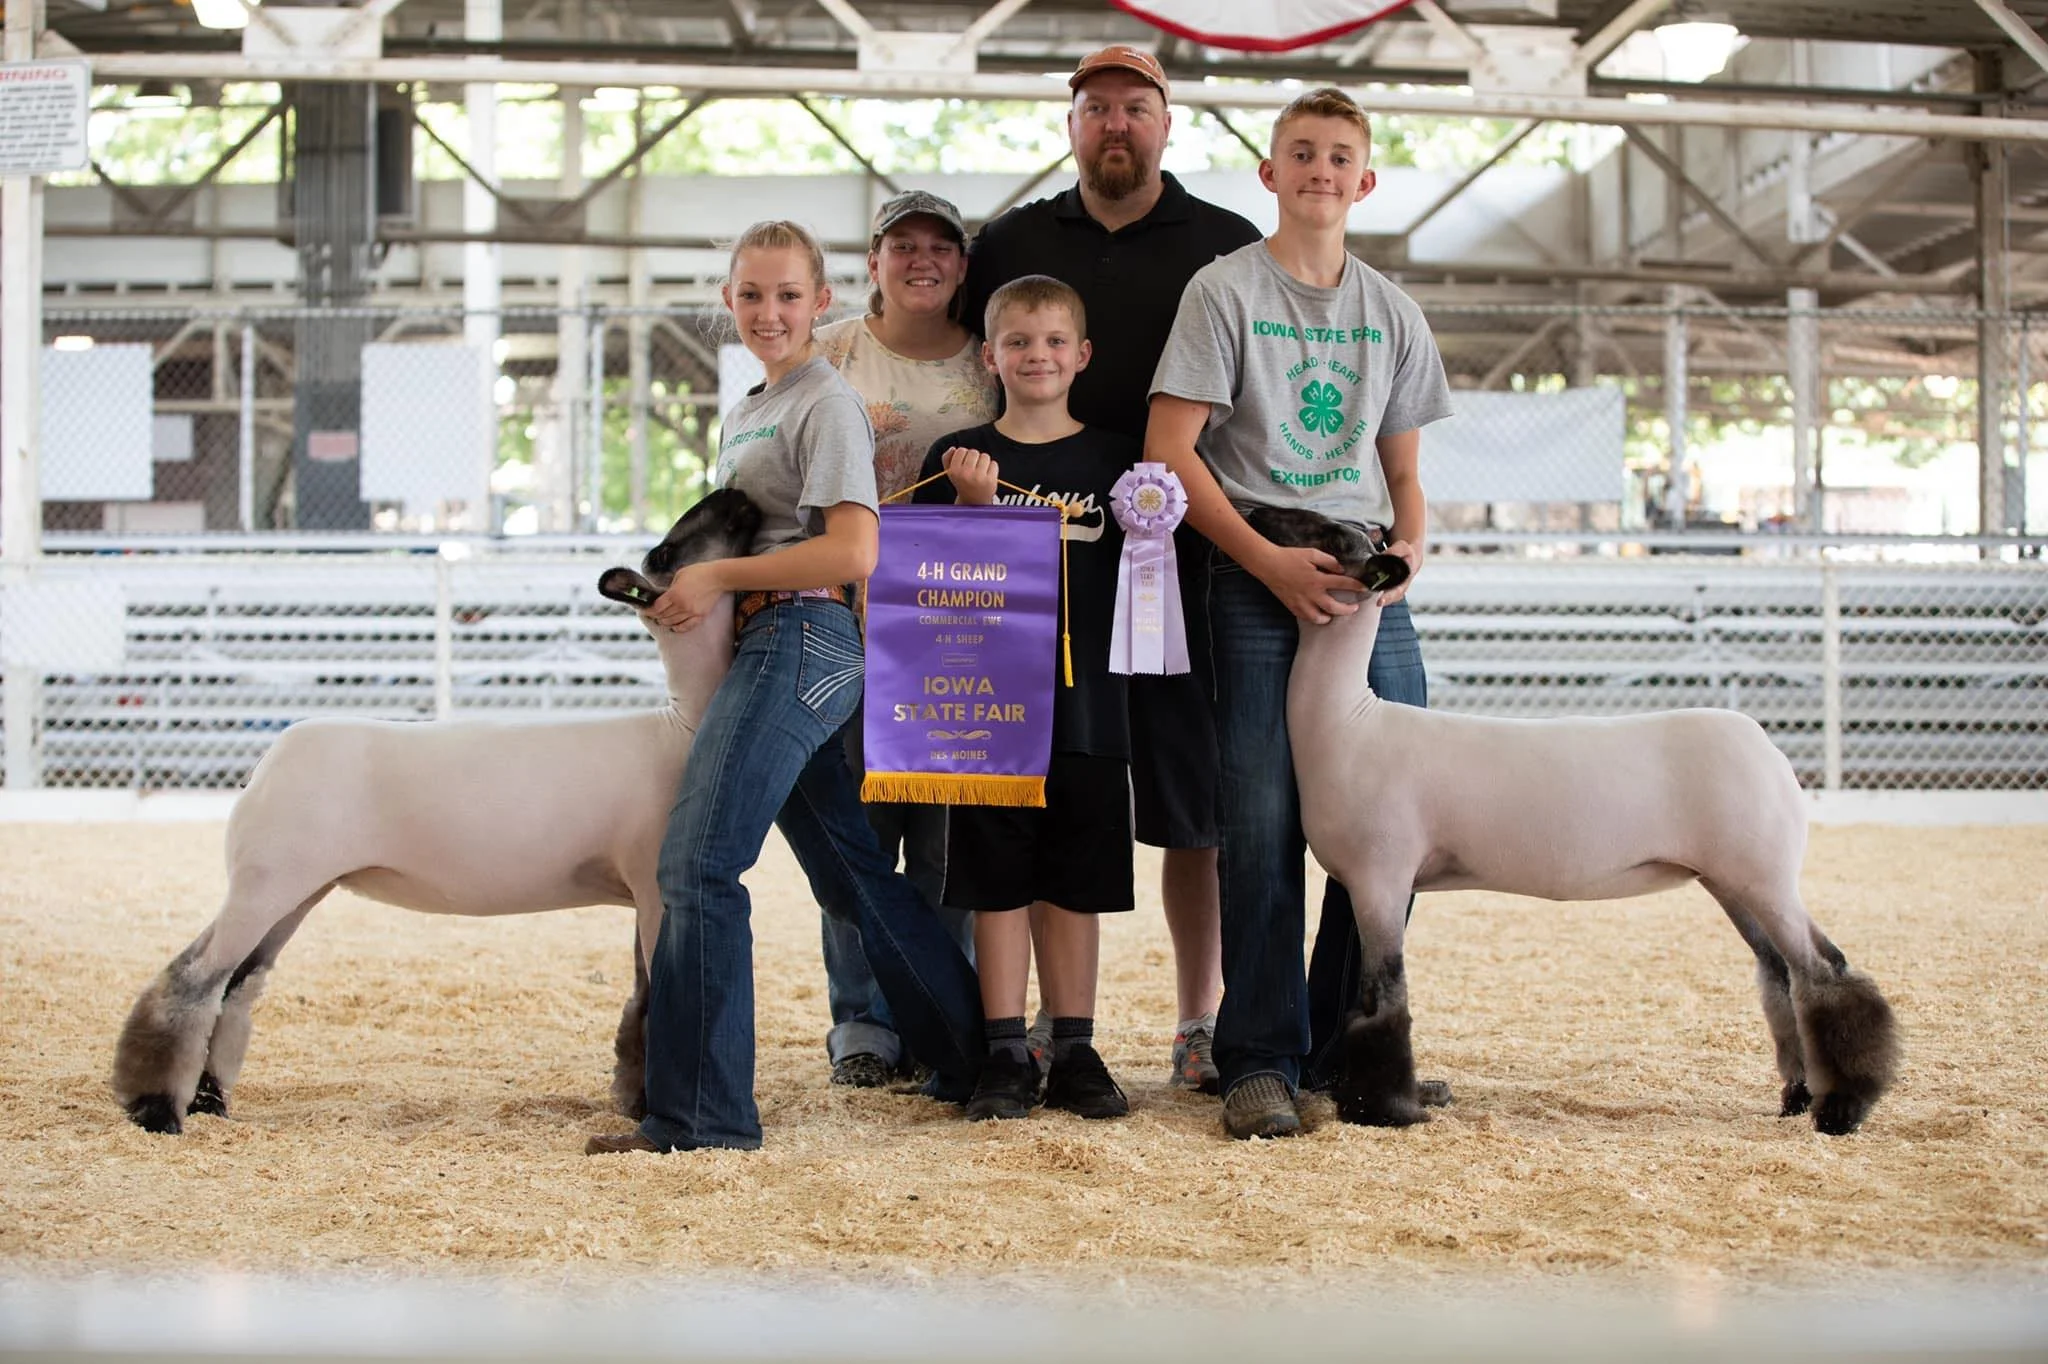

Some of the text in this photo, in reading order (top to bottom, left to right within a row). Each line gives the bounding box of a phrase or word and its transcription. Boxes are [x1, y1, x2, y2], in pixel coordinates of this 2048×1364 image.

[1253, 320, 1298, 341] IOWA
[1286, 357, 1318, 381] HEAD
[1279, 419, 1368, 461] HANDS HEALTH
[1270, 467, 1361, 488] EXHIBITOR
[917, 562, 1008, 582] 4-H GRAND
[917, 589, 1005, 609] CHAMPION
[919, 615, 977, 626] COMMERCIAL
[956, 634, 985, 645] SHEEP
[923, 676, 995, 696] IOWA
[893, 703, 1026, 723] STATE FAIR
[952, 750, 988, 761] MOINES
